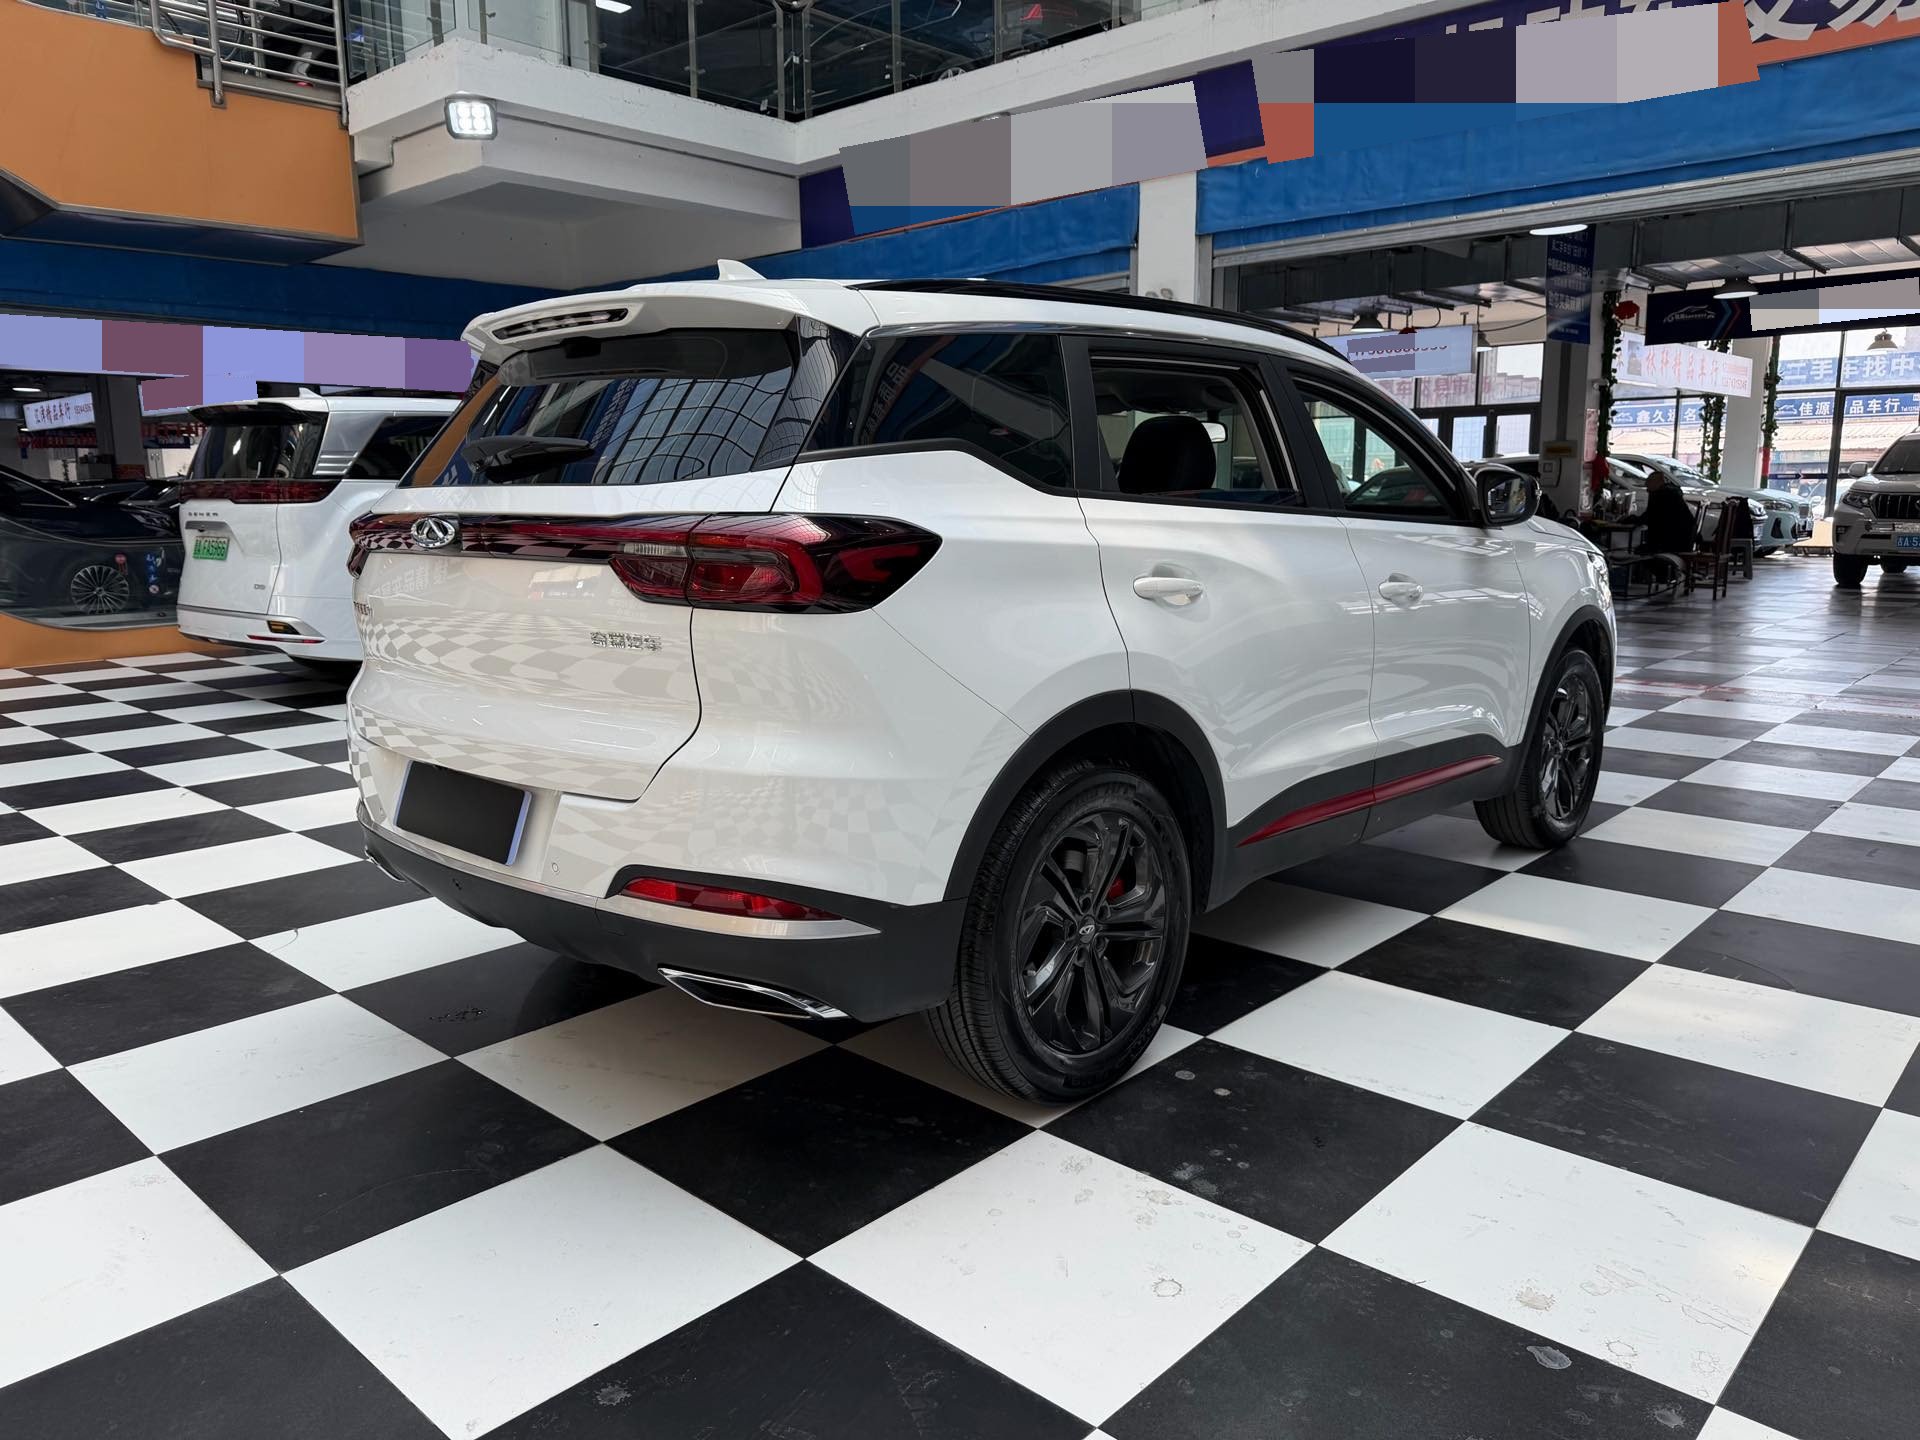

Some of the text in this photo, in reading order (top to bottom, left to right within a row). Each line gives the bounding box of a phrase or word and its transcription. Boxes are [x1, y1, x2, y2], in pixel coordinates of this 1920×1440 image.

[1784, 354, 1920, 380] 二手车找中
[1799, 397, 1900, 416] 佳源品车行
